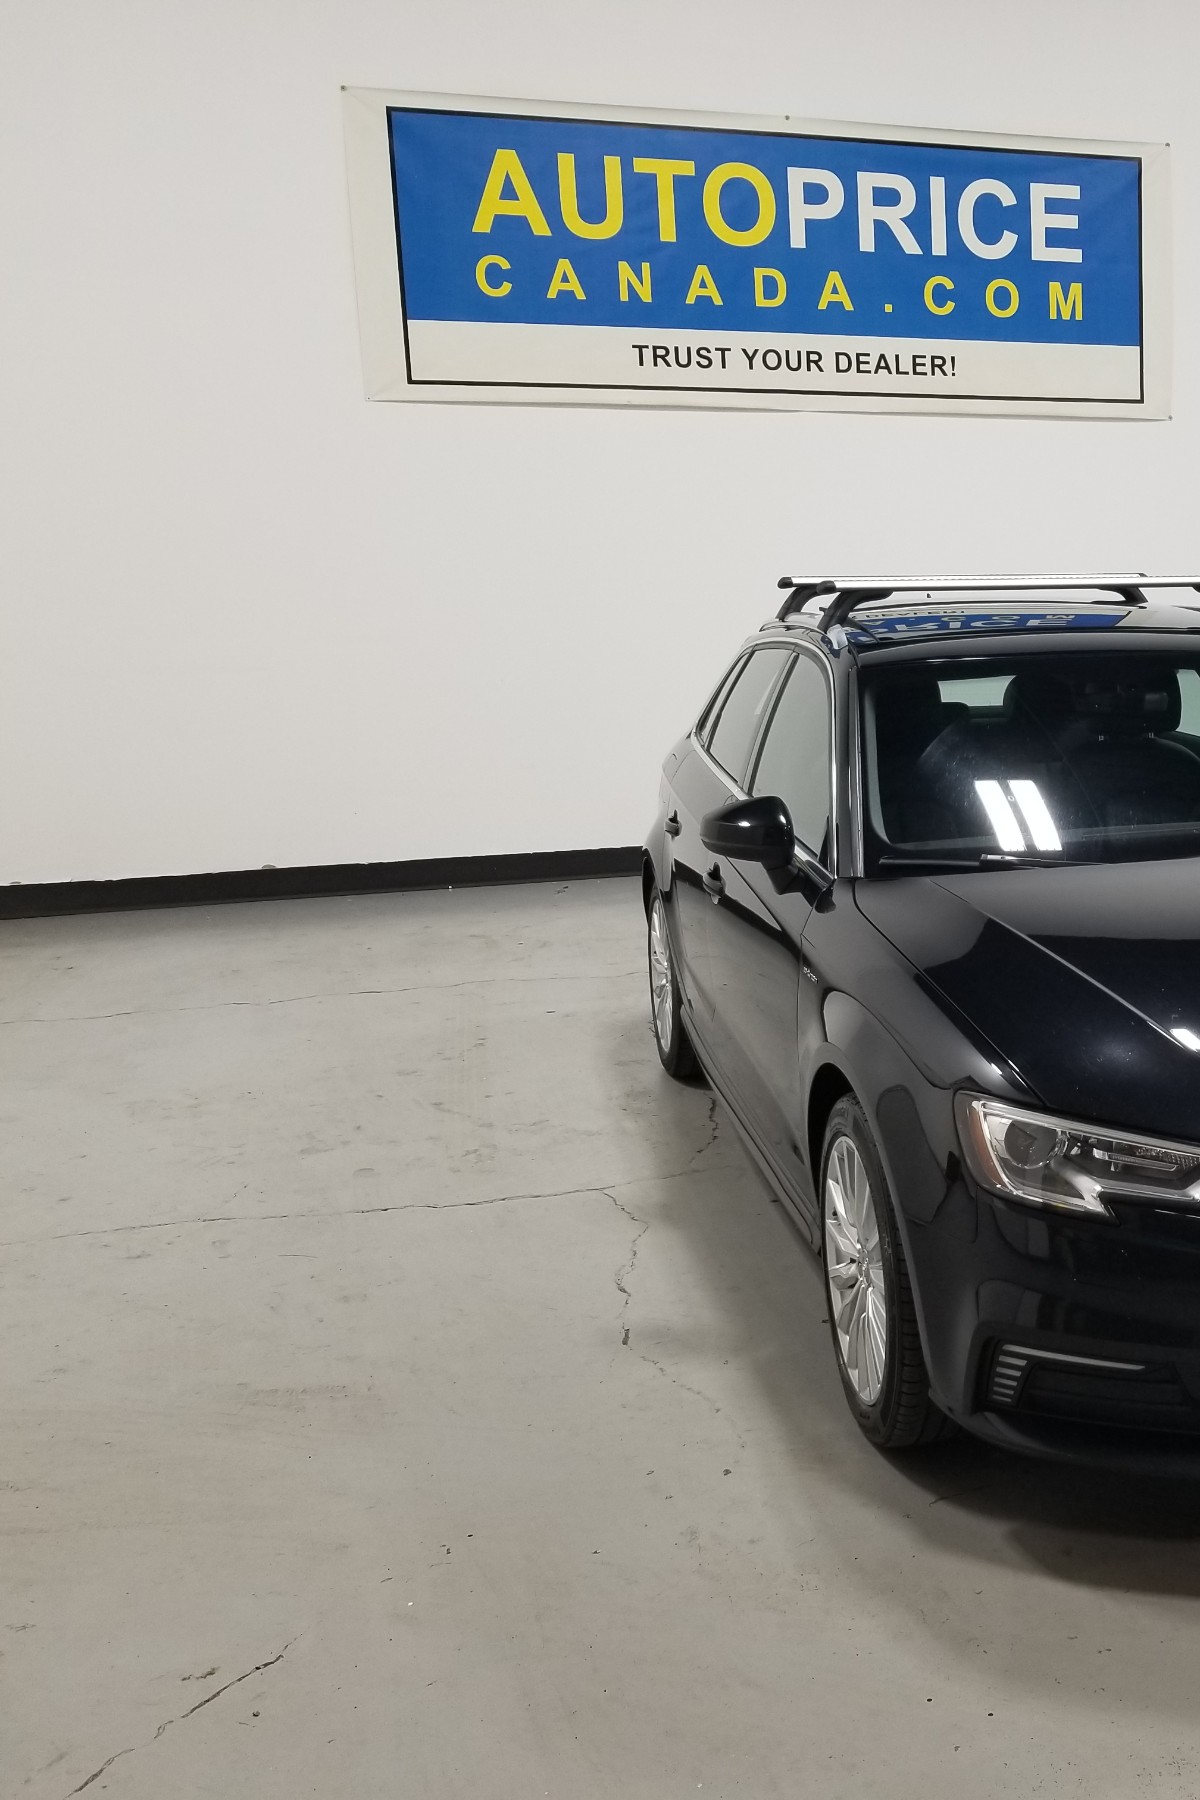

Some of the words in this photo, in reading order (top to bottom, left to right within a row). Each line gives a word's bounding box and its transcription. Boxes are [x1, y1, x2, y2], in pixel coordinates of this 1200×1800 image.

[471, 149, 1083, 263] AUTOPRICE
[631, 344, 732, 369] TRUST
[741, 348, 825, 373] YOUR
[834, 351, 956, 377] DEALER!
